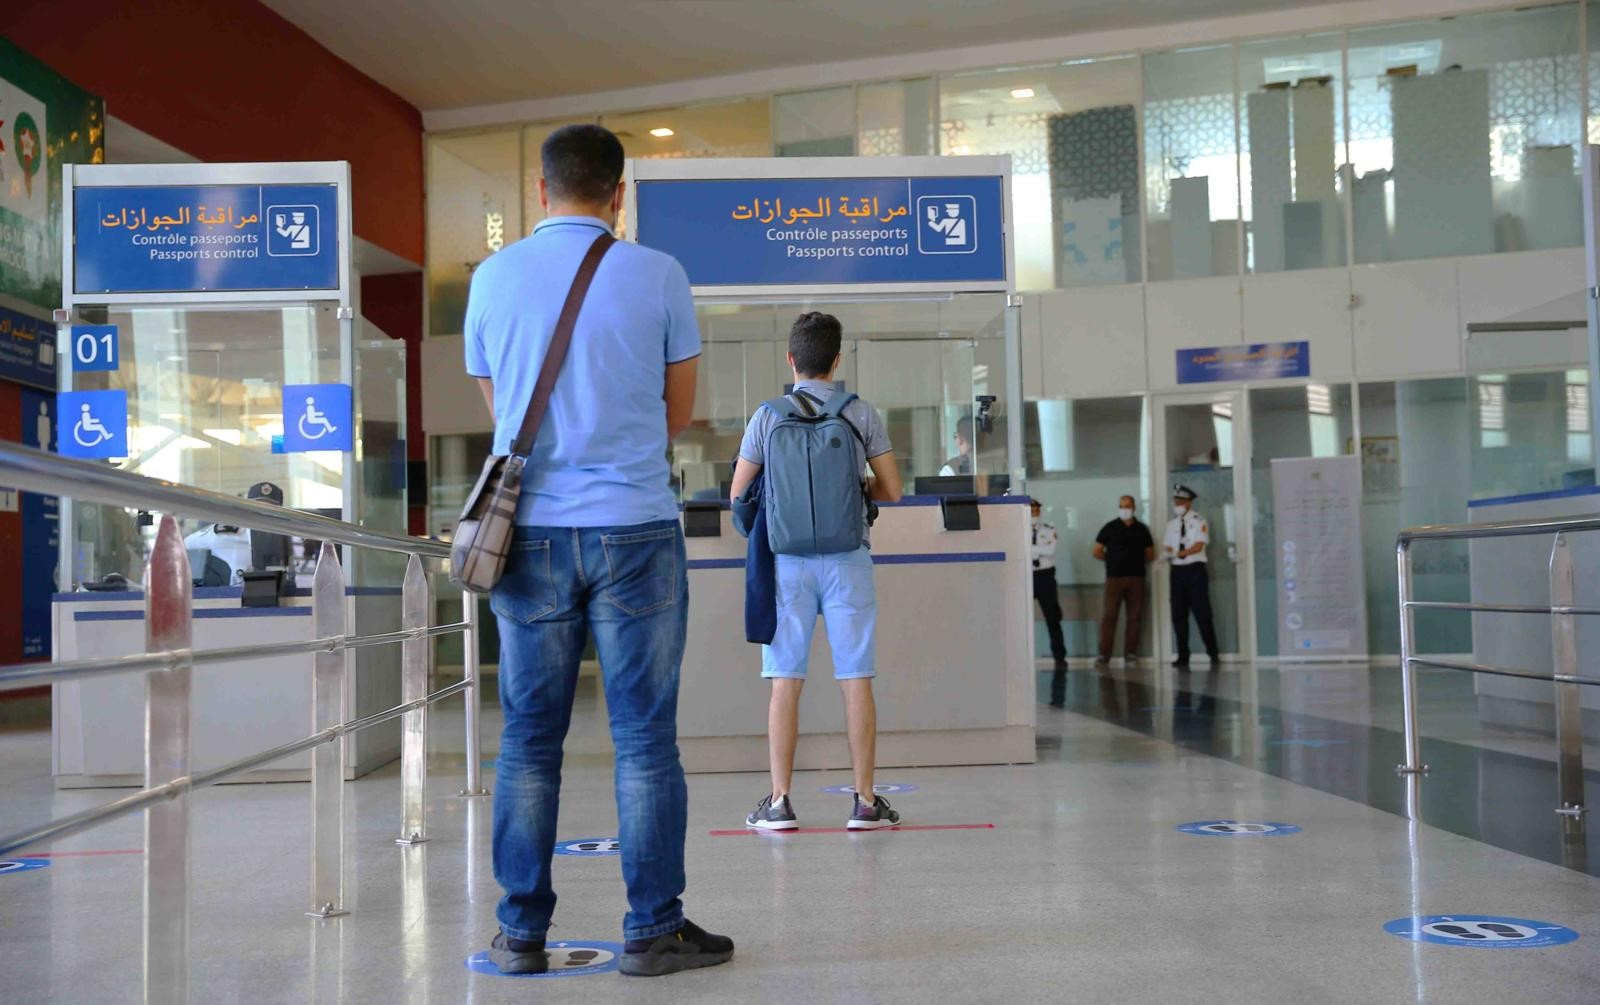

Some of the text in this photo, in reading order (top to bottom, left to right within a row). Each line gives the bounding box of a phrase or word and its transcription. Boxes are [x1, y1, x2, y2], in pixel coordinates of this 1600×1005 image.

[101, 205, 258, 231] مراقبة الجوازات
[732, 196, 908, 225] مراقبة الجوازات
[131, 234, 259, 249] Contrôle passeports
[766, 227, 908, 243] Contrôle passeports
[150, 247, 259, 262] Passports control
[787, 243, 909, 259] Passports control
[76, 333, 113, 363] 01
